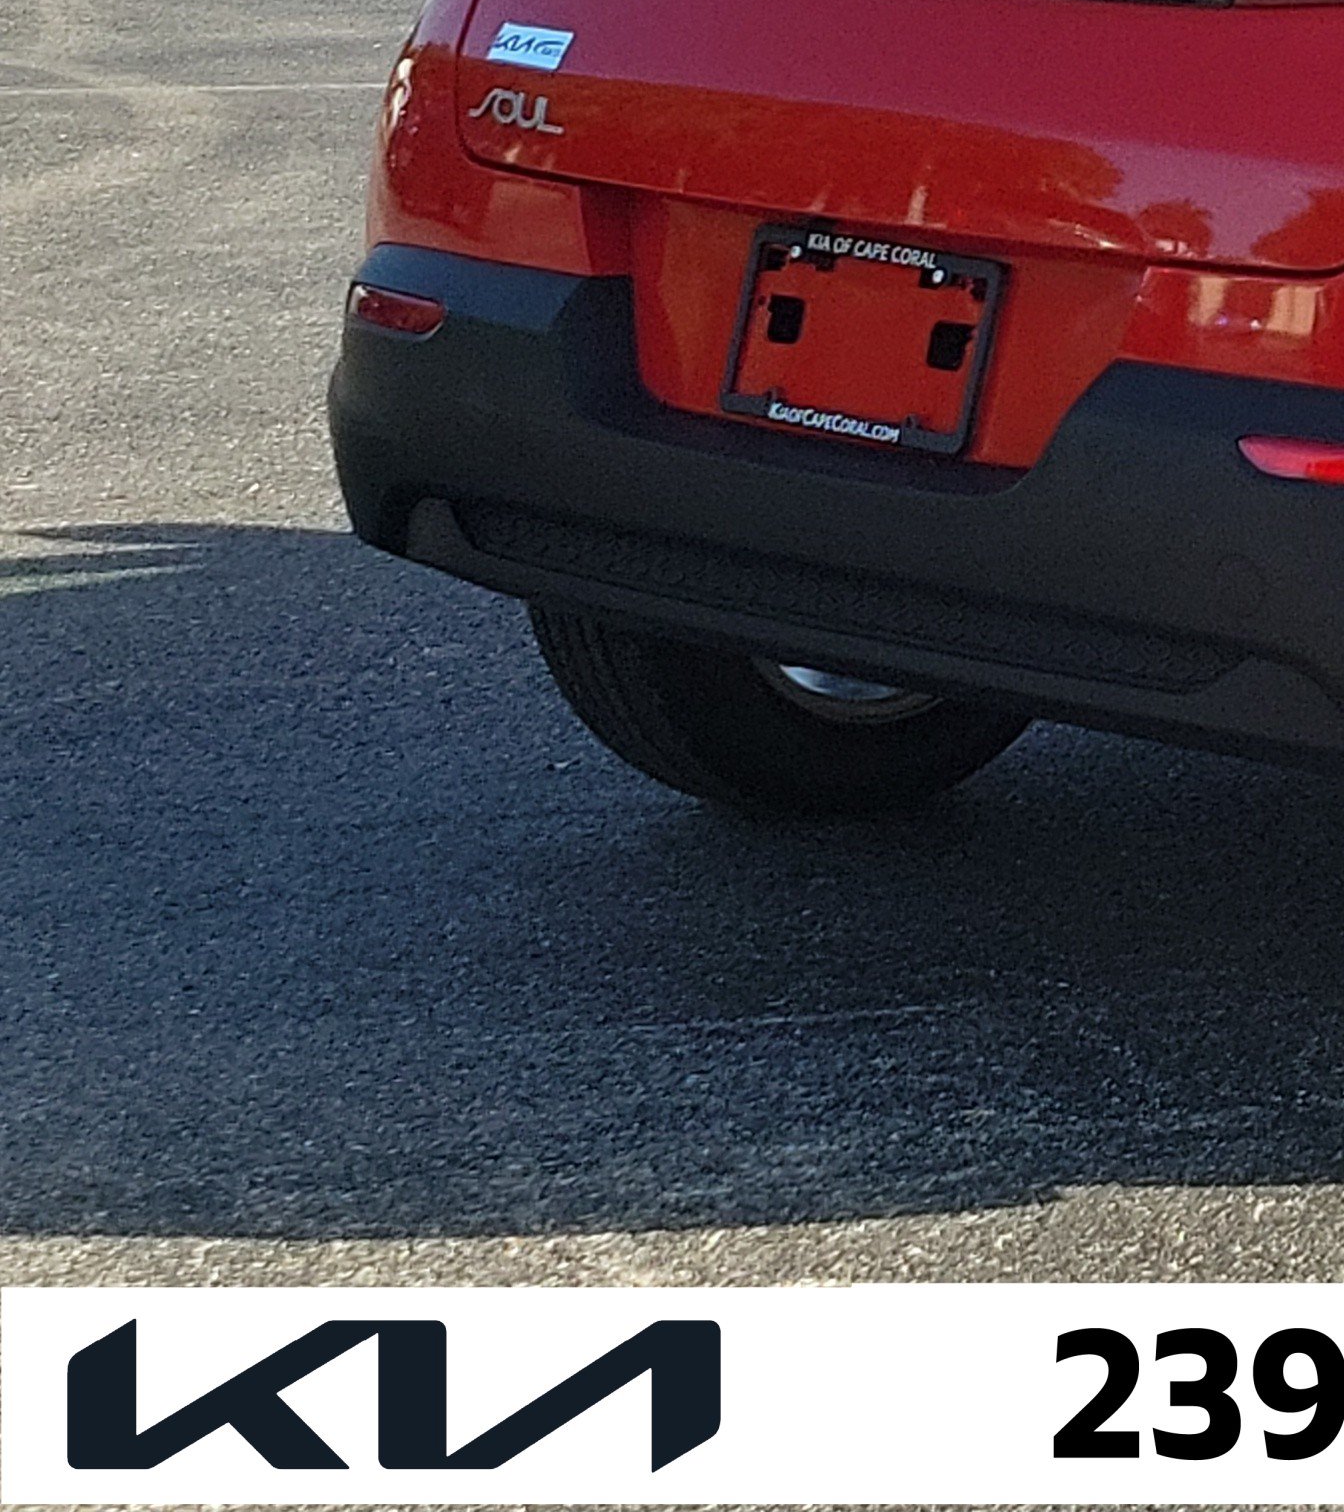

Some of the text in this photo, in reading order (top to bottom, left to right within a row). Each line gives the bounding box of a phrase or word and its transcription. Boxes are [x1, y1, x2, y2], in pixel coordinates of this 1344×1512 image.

[468, 88, 565, 135] SOUL
[807, 233, 938, 269] KIA OF CAPE CORAL
